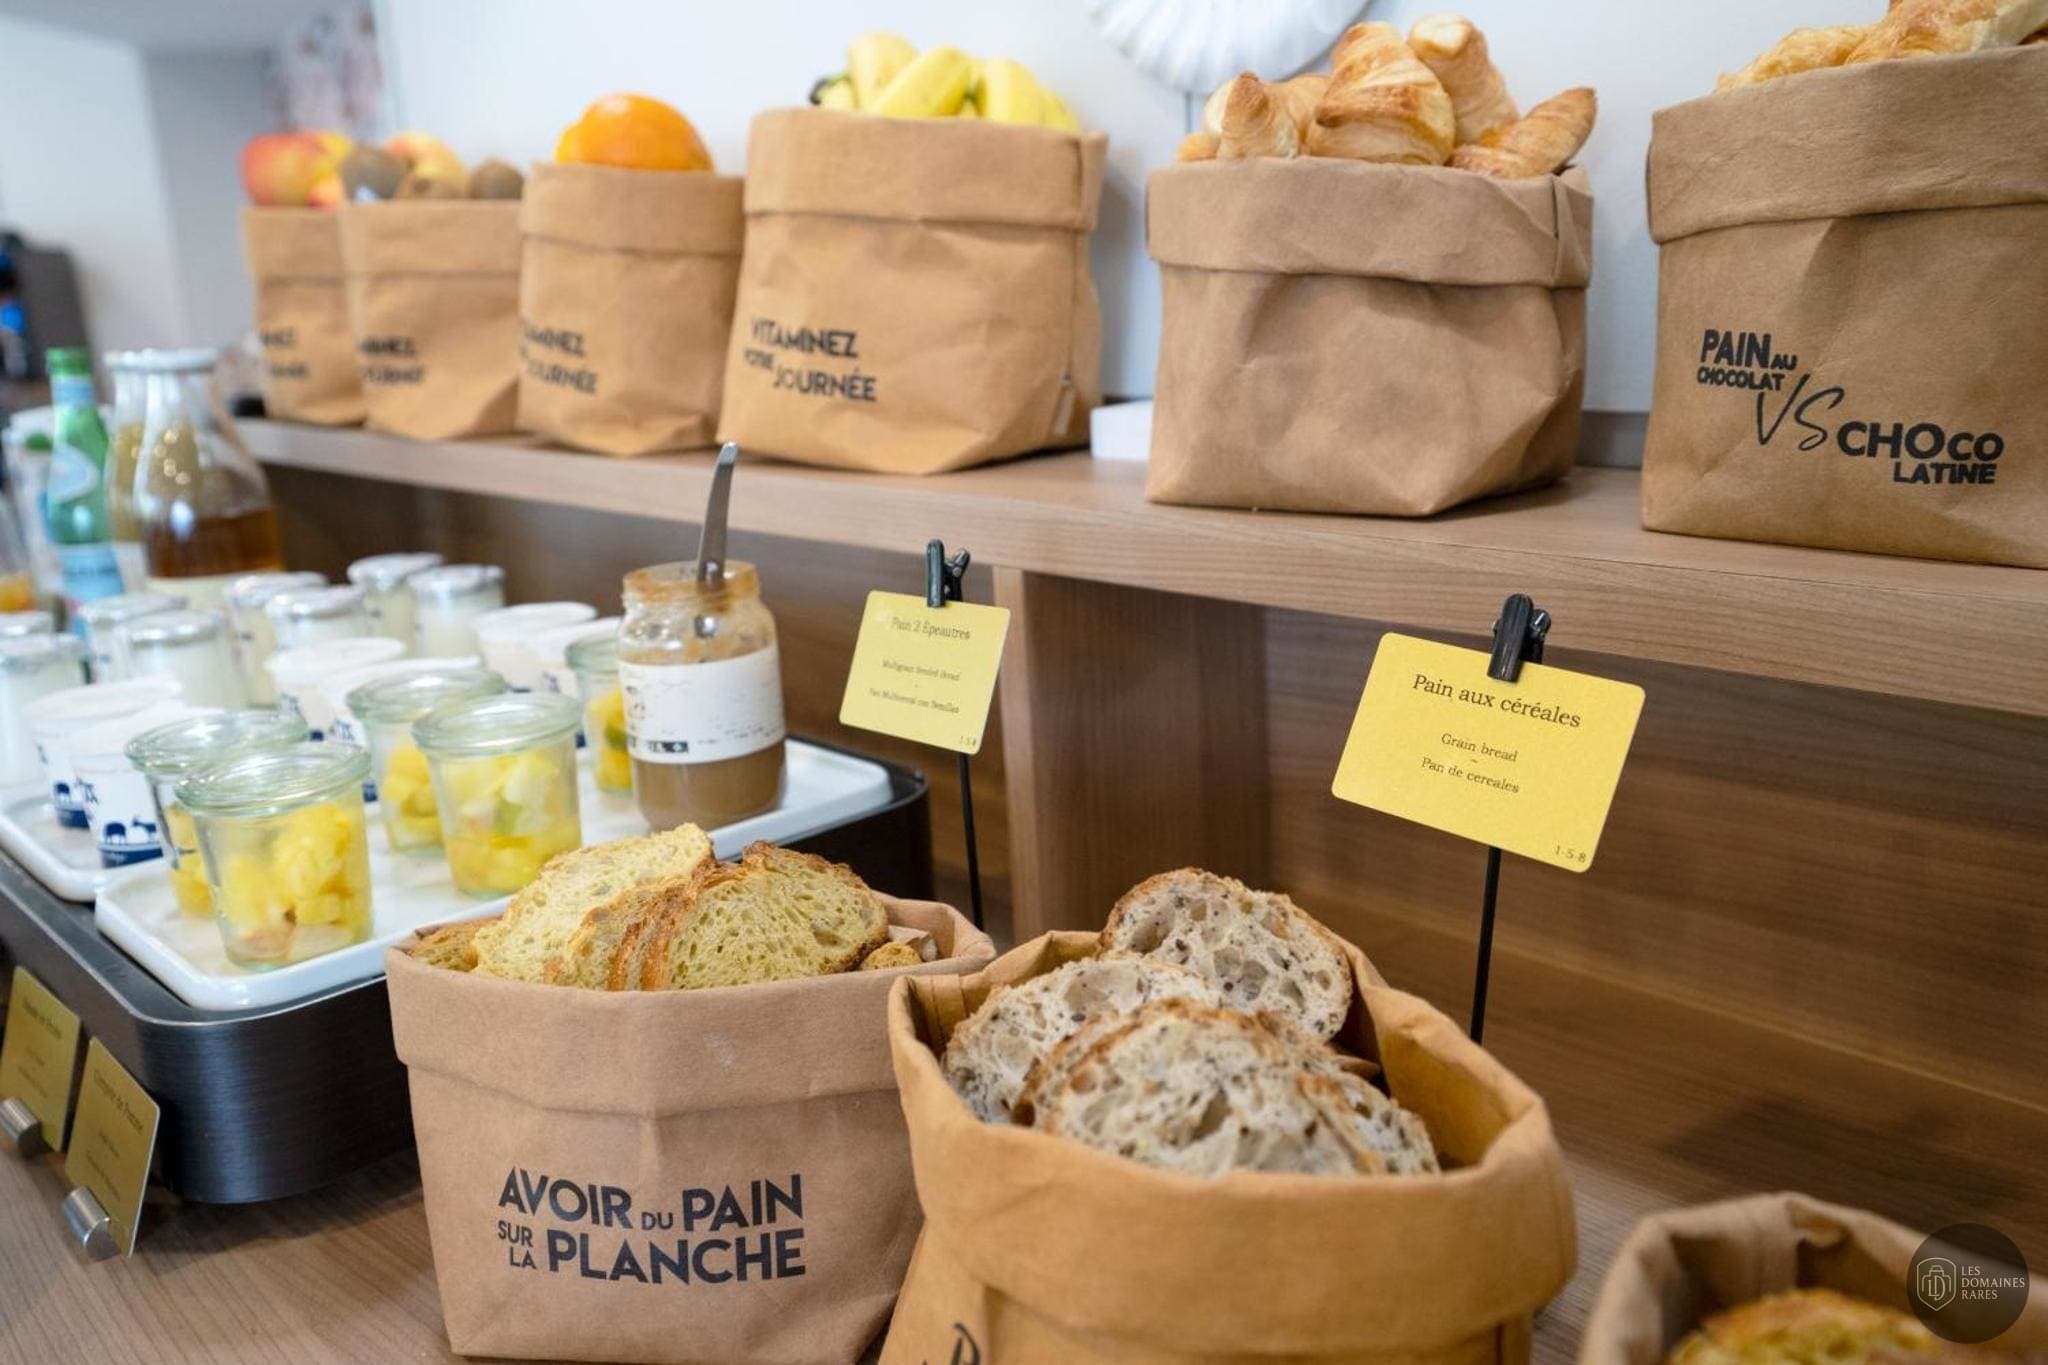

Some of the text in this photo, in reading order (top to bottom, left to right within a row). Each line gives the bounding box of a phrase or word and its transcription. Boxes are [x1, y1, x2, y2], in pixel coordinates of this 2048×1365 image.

[1700, 329, 1798, 371] PAIN AU
[1697, 367, 1786, 392] CHOCOLAT
[1756, 373, 1845, 451] VS
[1893, 462, 1998, 485] LATINE
[913, 619, 922, 633] 2
[1412, 673, 1582, 728] Pain aux céréales
[1441, 732, 1519, 762] Grain bread
[1421, 756, 1520, 794] Pan de cereales
[498, 1166, 803, 1232] AVOIR DU PAIN
[498, 1219, 533, 1248] SUR
[509, 1228, 806, 1285] LA PLANCHE
